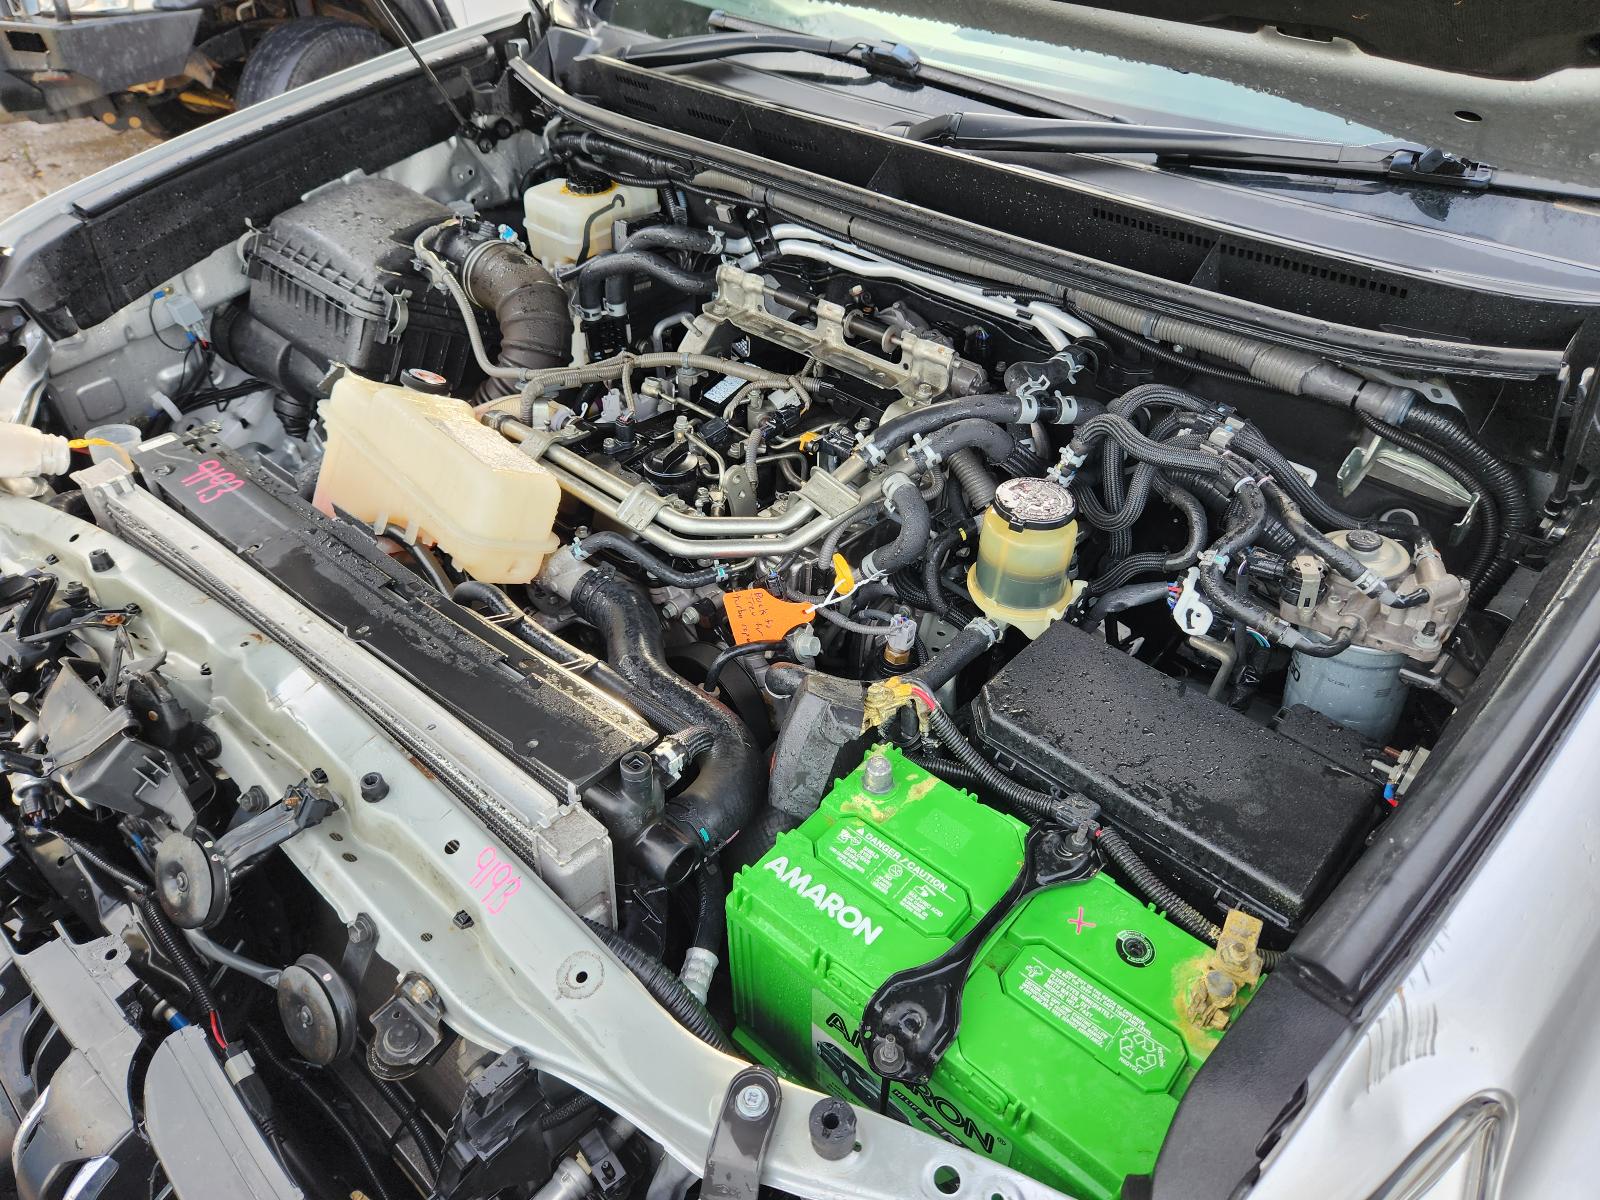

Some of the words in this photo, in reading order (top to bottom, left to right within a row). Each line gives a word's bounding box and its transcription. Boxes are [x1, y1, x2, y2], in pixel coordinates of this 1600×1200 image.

[468, 846, 522, 915] 9193
[864, 832, 902, 860] DANGER
[907, 860, 949, 892] CAUTION
[763, 856, 884, 946] AMARON
